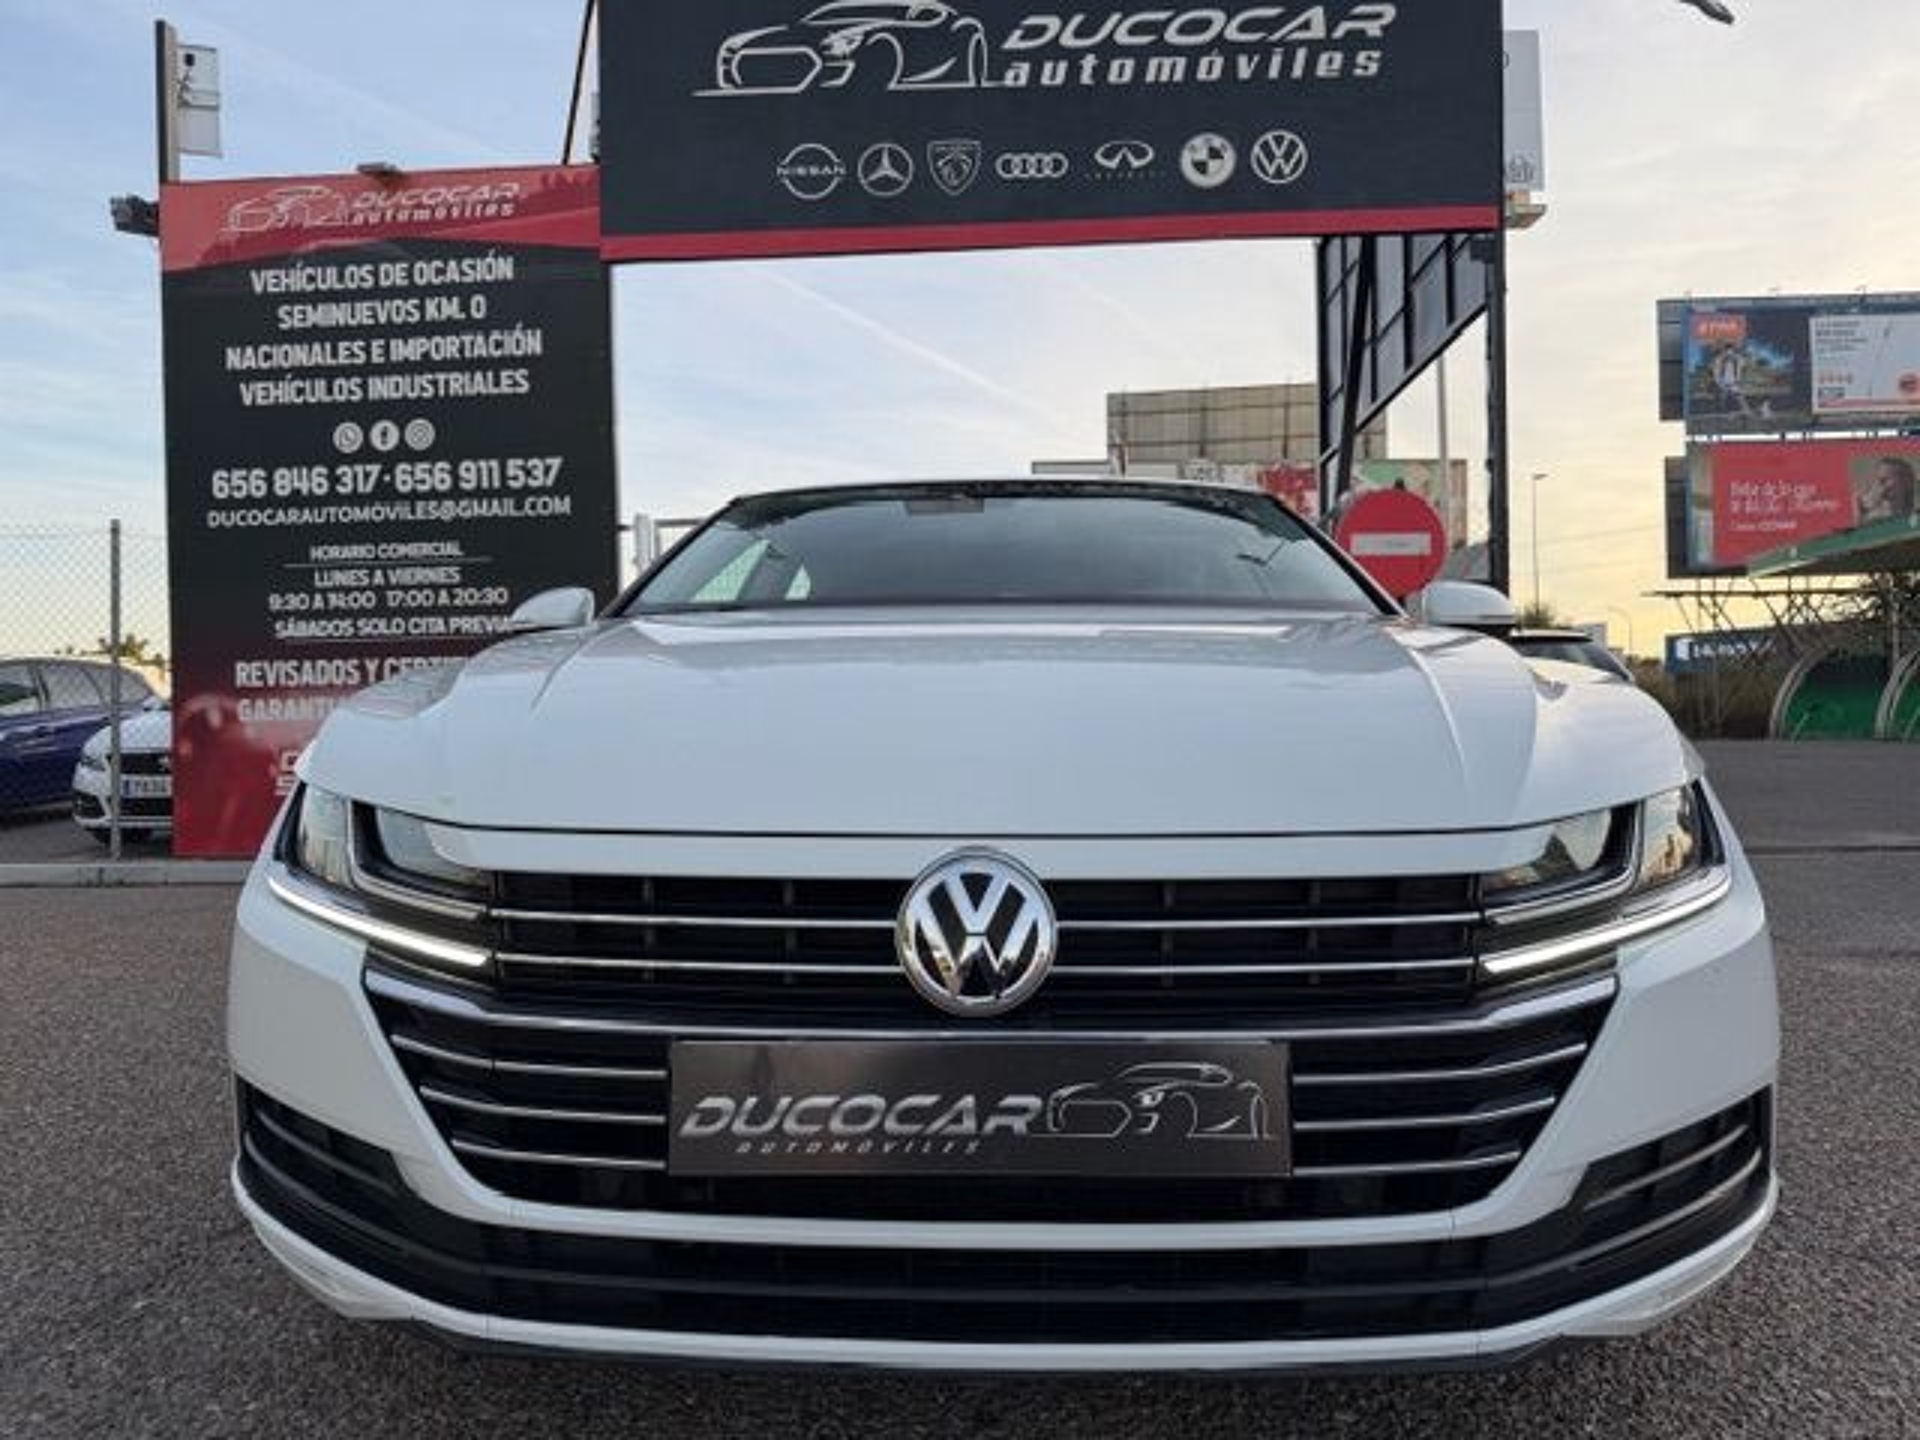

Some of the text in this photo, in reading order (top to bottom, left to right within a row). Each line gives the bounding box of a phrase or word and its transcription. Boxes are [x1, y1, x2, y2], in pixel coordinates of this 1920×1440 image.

[1002, 4, 1397, 50] DUCOCAR
[1004, 47, 1383, 87] automóviles
[352, 182, 521, 208] DUCOCAR
[251, 250, 514, 294] VEHÍCULOS DE OCASIÓN
[278, 299, 420, 330] SEMINUEVOS
[425, 297, 465, 322] KM.
[225, 323, 543, 370] NACIONALES E IMPORTACIÓN
[239, 369, 530, 406] VEHÍCULOS INDUSTRIALES
[211, 469, 268, 499] 656
[273, 467, 330, 496] 846
[457, 460, 501, 489] 911
[506, 457, 563, 489] 537
[314, 566, 461, 587] LUNES A VIERNES
[312, 592, 325, 610] A
[386, 588, 435, 608] 17:00
[437, 588, 451, 606] A
[453, 586, 508, 606] 20:30
[357, 615, 406, 636] SOLO
[408, 615, 446, 635] CITA
[234, 658, 361, 688] REVISADOS
[363, 658, 380, 684] Y
[680, 1094, 1042, 1137] DUCOCAR
